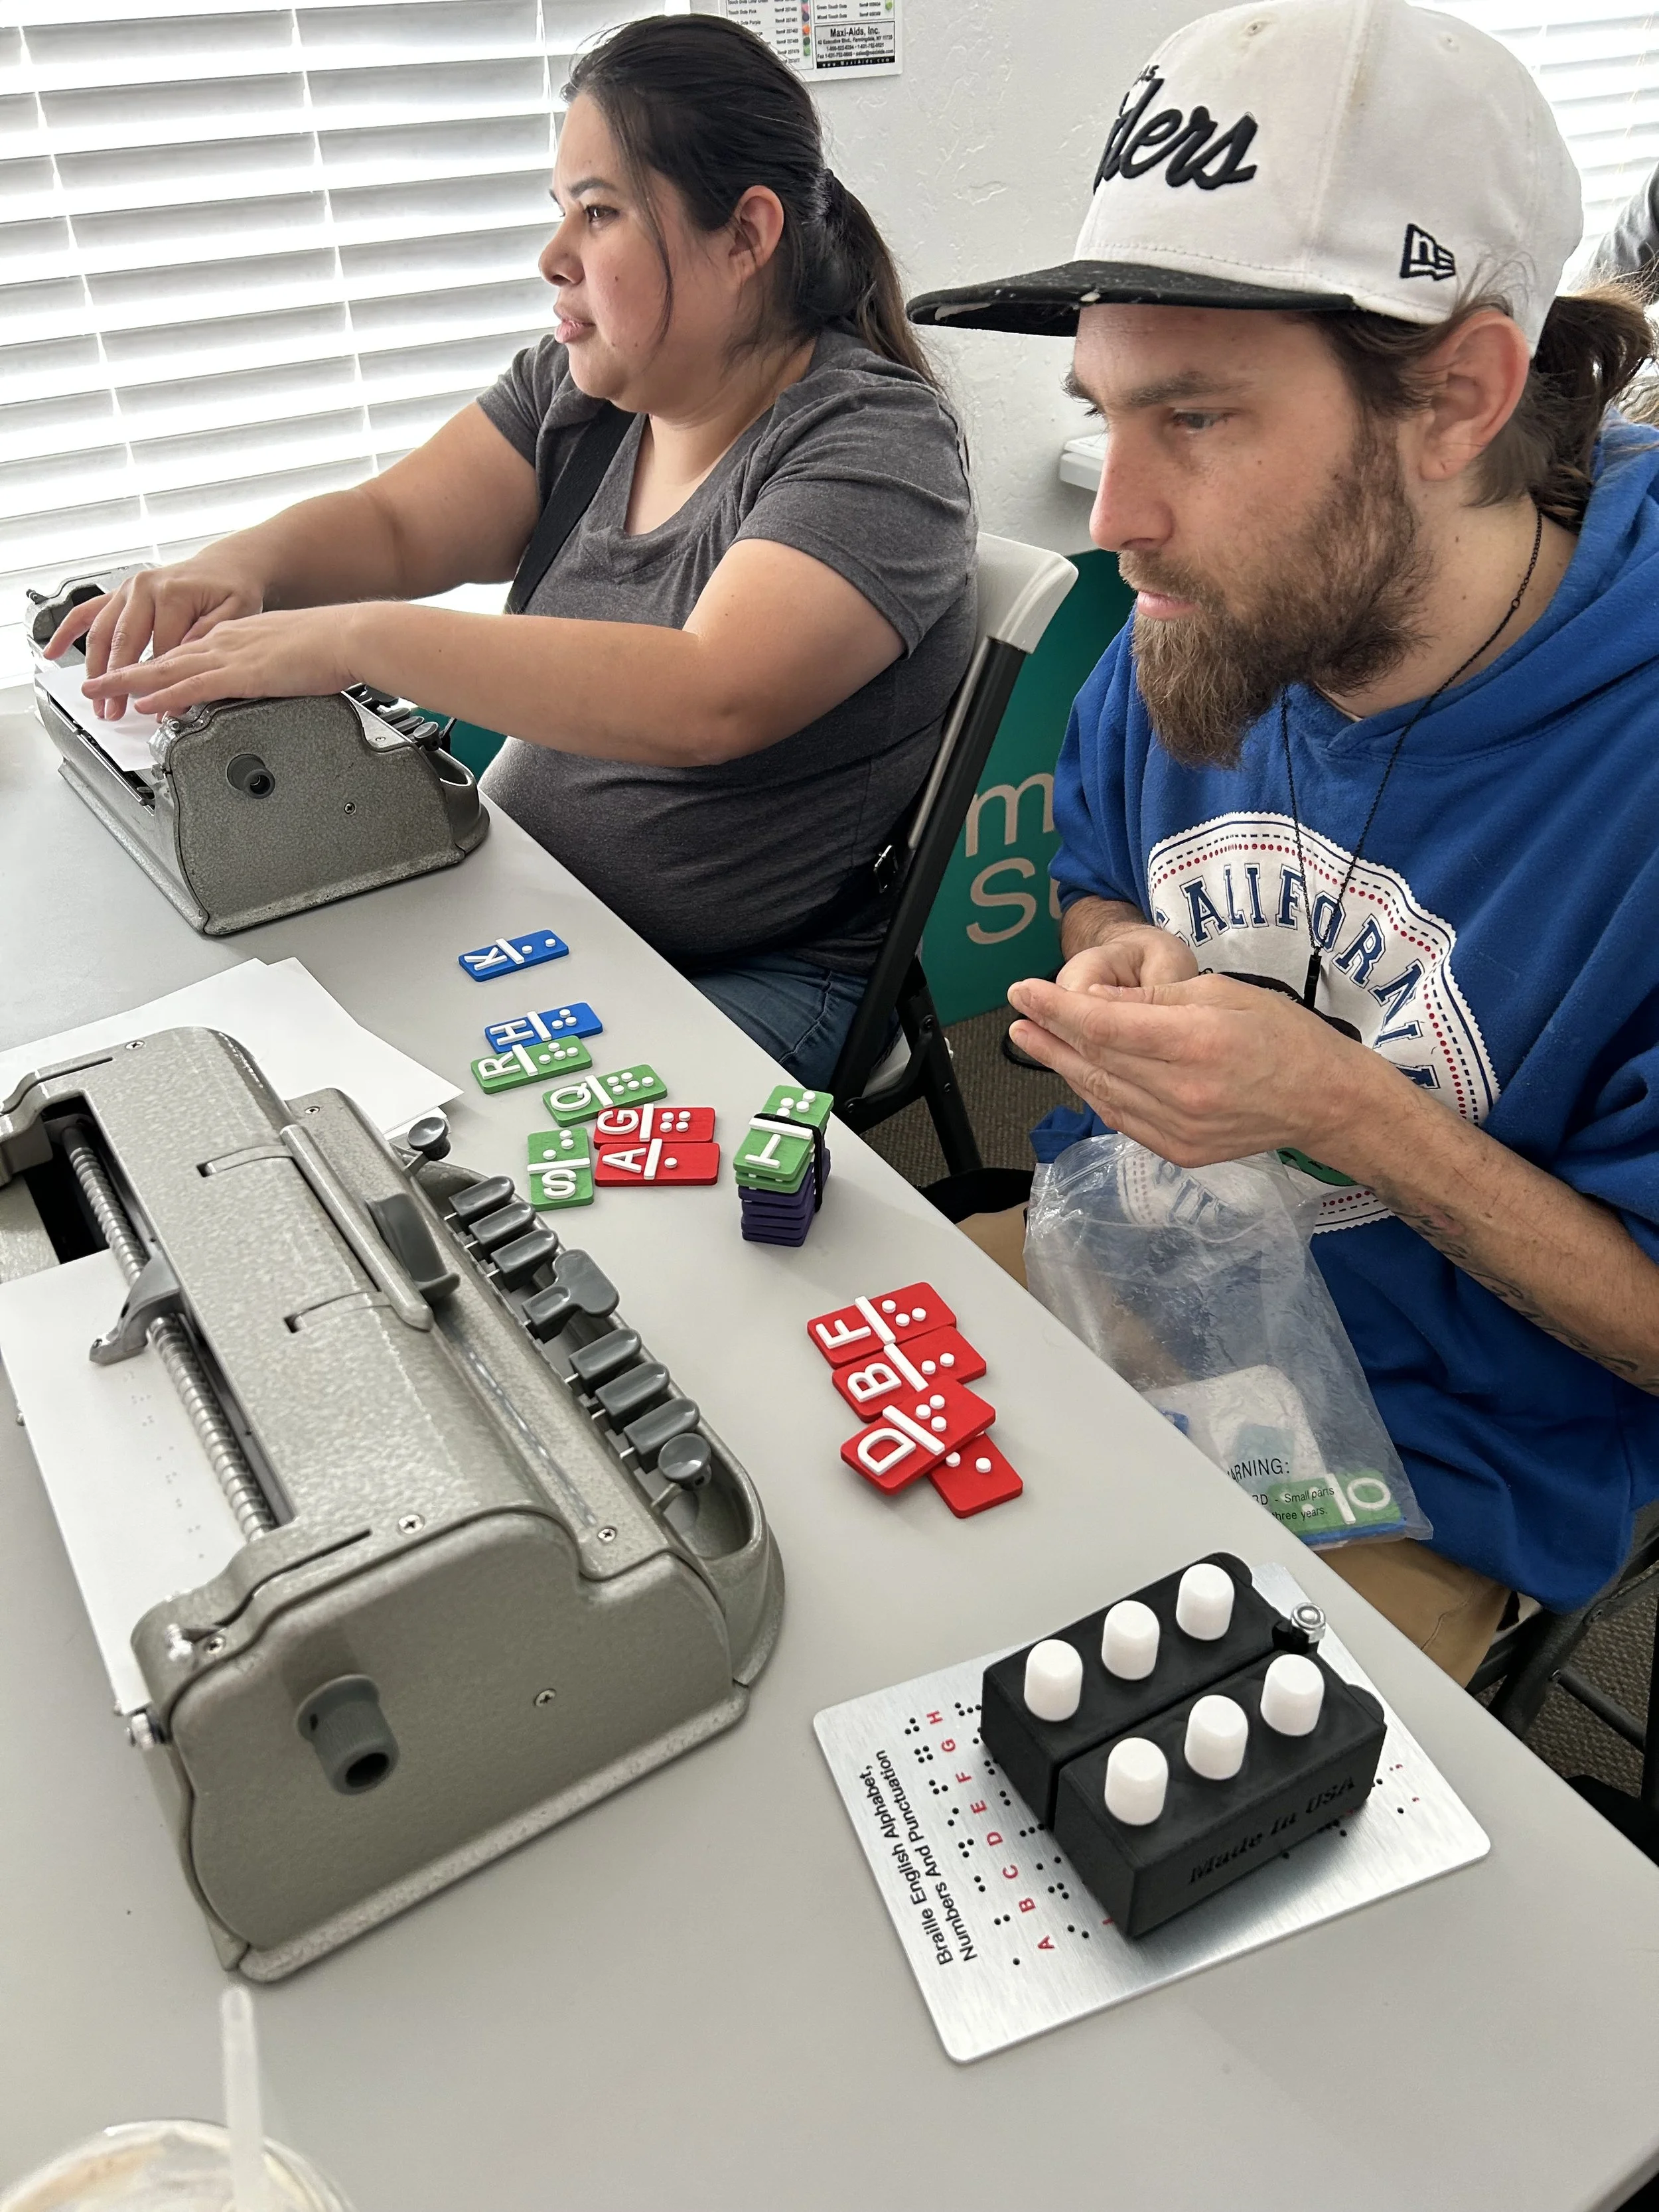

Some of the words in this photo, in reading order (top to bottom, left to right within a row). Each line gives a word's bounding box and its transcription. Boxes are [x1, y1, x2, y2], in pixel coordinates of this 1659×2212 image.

[830, 27, 866, 37] Maxi-Aids,
[867, 26, 881, 35] Inc.
[1094, 78, 1258, 195] ders
[465, 947, 507, 970] K
[489, 1020, 534, 1045] H
[478, 1051, 520, 1080] R
[550, 1082, 591, 1112] Q
[597, 1108, 639, 1136] G
[602, 1147, 646, 1173] A
[541, 1168, 577, 1199] S
[816, 1319, 871, 1349] F
[847, 1363, 901, 1402] B
[857, 1428, 916, 1476] D
[1228, 1458, 1289, 1483] ARNING:
[1285, 1489, 1310, 1503] Small
[1311, 1487, 1334, 1501] parts
[1301, 1507, 1328, 1521] years.
[926, 1711, 943, 1724] H
[941, 1738, 956, 1752] G
[956, 1771, 972, 1783] F
[859, 1765, 900, 1839] Alphabet,
[876, 1749, 924, 1842] Punctuation
[970, 1799, 987, 1814] E
[987, 1831, 1003, 1846] D
[892, 1843, 928, 1905] English
[914, 1845, 942, 1877] And
[1002, 1864, 1018, 1880] C
[1019, 1898, 1036, 1913] B
[935, 1881, 978, 1962] Numbers
[922, 1907, 954, 1965] Braille
[1037, 1935, 1055, 1951] A
